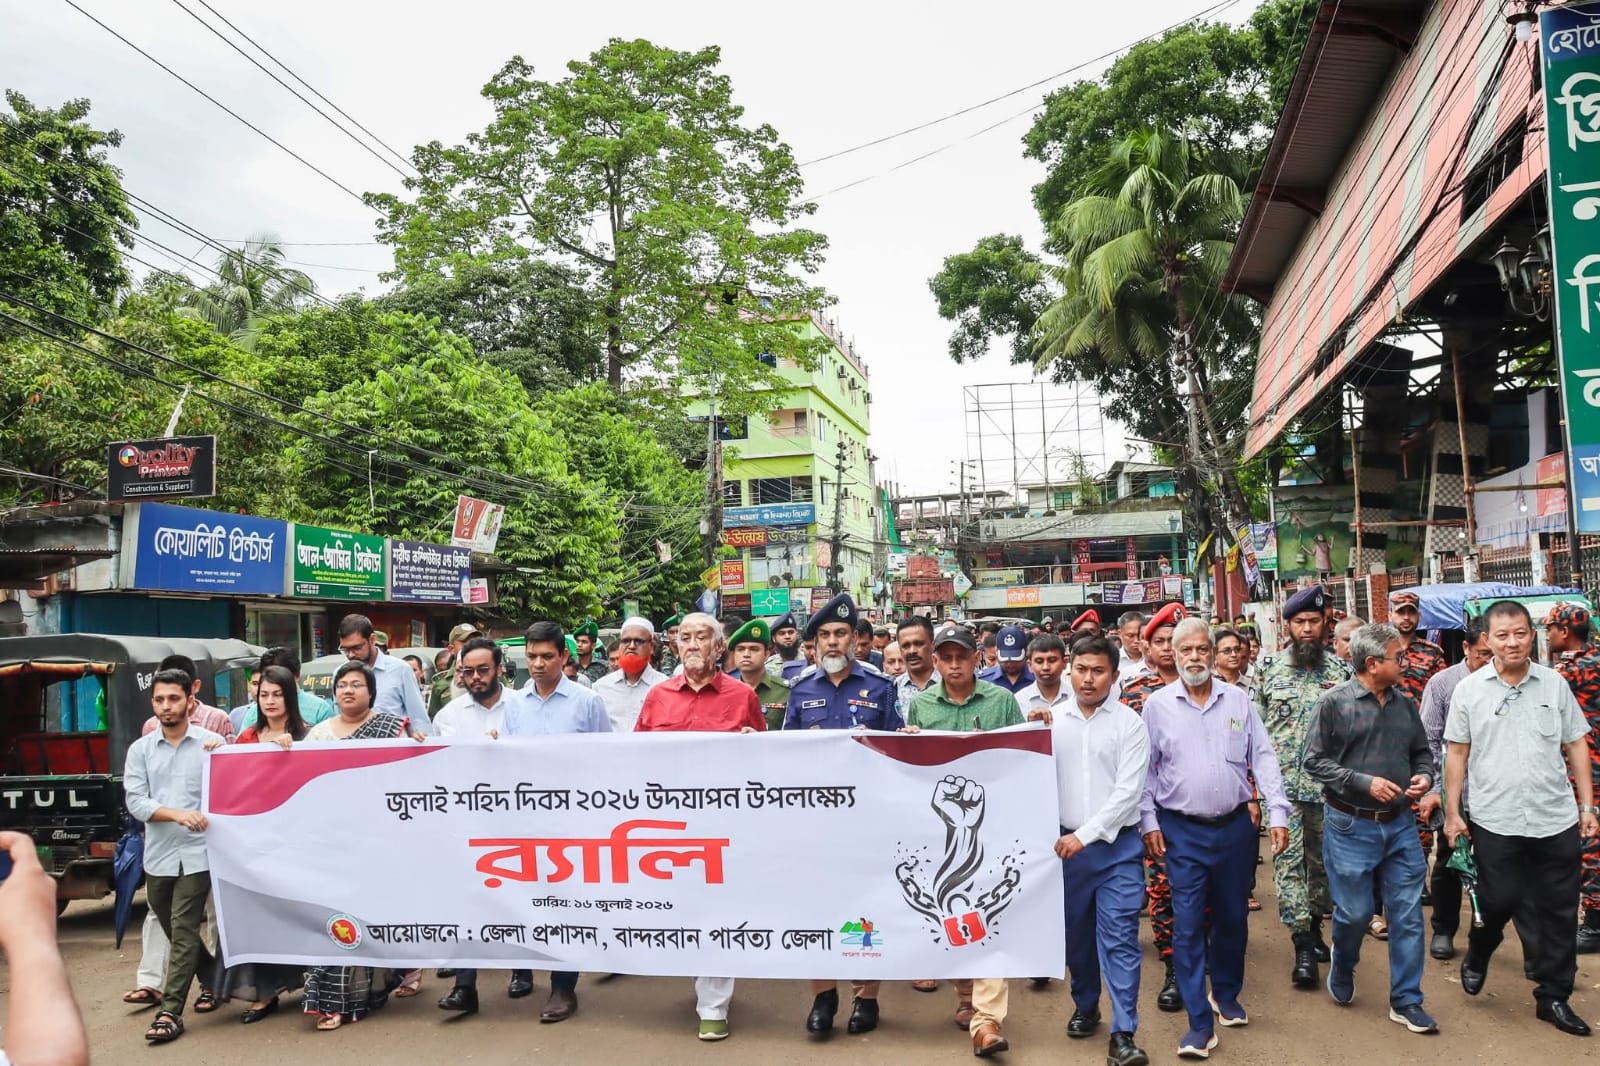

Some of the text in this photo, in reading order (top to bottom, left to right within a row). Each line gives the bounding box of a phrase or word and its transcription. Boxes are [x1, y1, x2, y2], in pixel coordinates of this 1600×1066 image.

[119, 443, 199, 467] Quality
[140, 466, 190, 476] Printers
[125, 485, 158, 493] Construction
[165, 482, 189, 491] Suppliers
[155, 524, 275, 562] কোয়ালিটি প্রিন্টার্স
[385, 781, 856, 821] জুলাই শহিদ দিবস ২০২৬ উদযাপন উপলক্ষ্যে
[469, 819, 730, 888] র‍্যালি
[531, 896, 673, 913] তারিখ: ১৬ জুলাই ২০২৬
[366, 923, 459, 944] আয়োজনে
[480, 924, 526, 944] জেলা
[613, 927, 702, 950] বান্দরবান
[709, 921, 774, 950] পার্বত্য
[781, 927, 834, 950] জেলা
